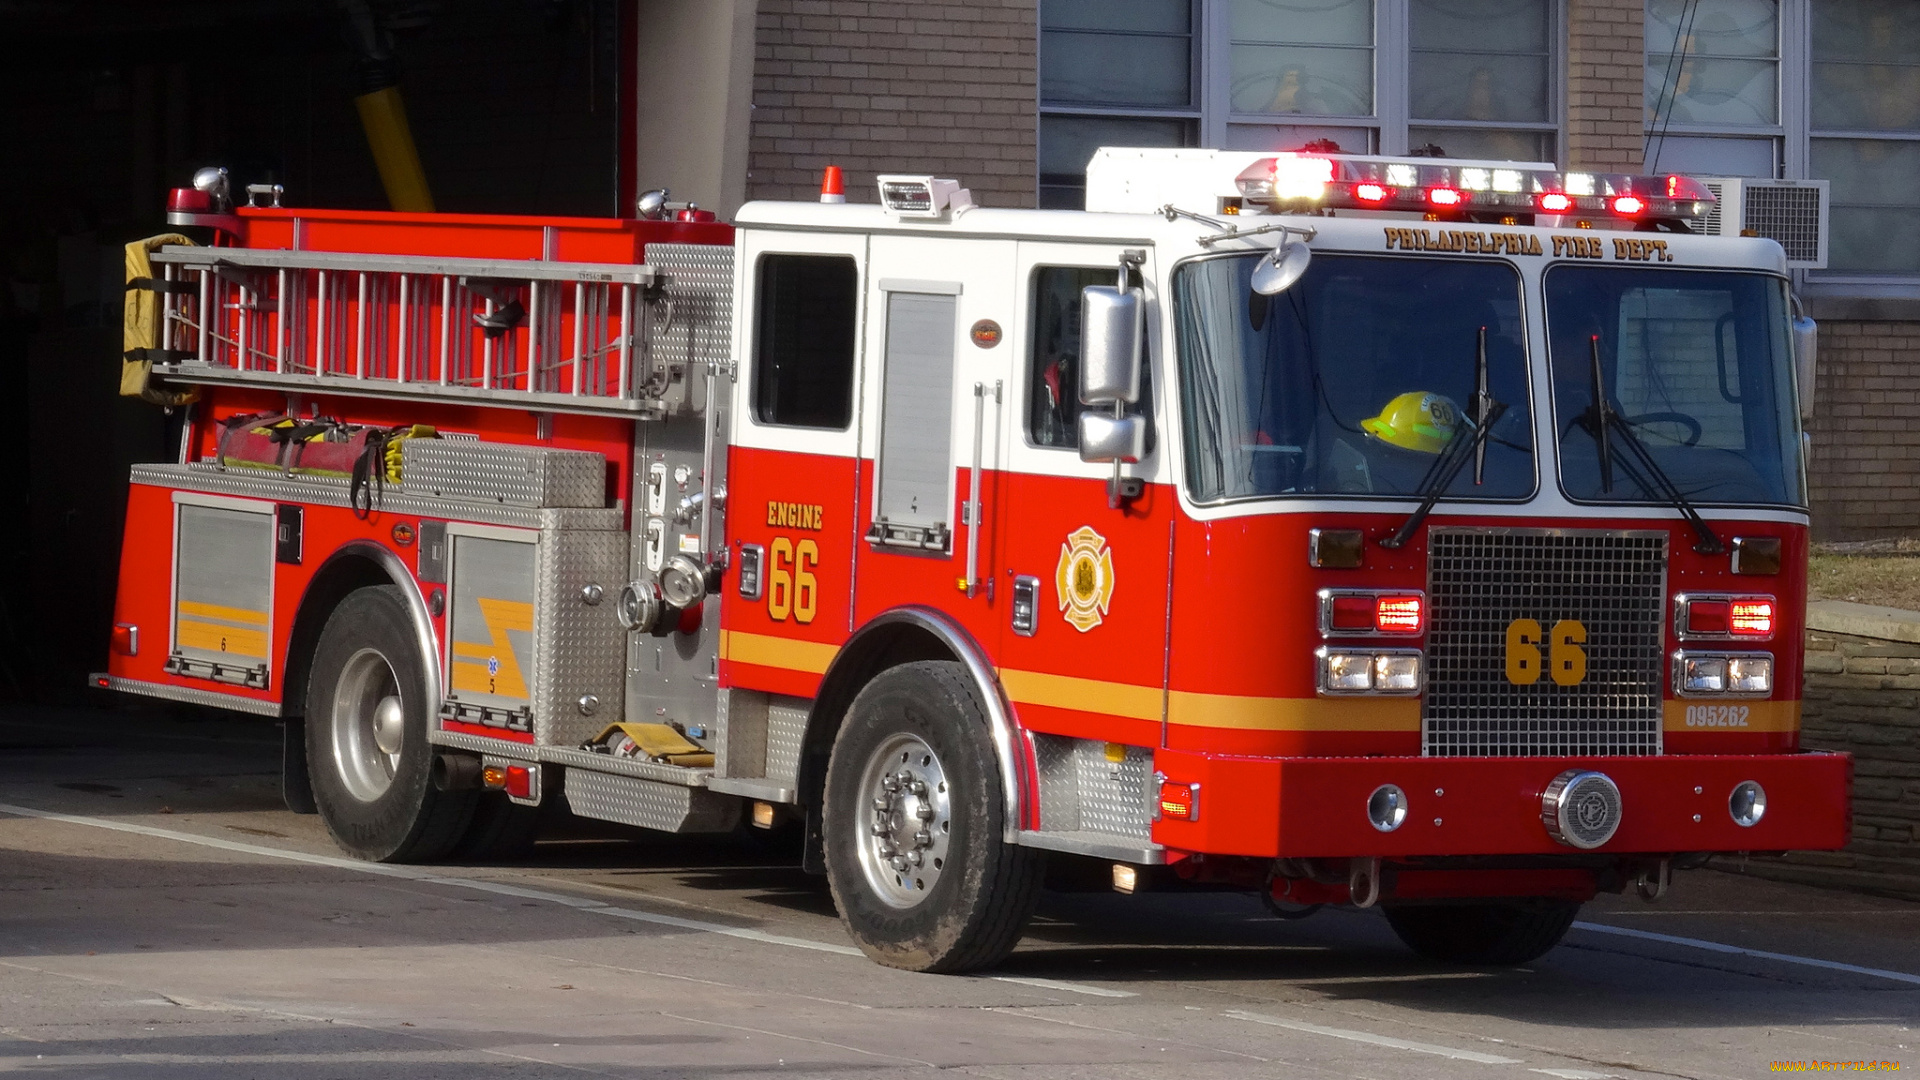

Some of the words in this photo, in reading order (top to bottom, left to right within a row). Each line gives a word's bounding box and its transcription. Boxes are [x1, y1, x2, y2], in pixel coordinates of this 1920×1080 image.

[1384, 227, 1543, 256] PHILADELPHIA
[1551, 235, 1603, 259] FIRE
[1613, 238, 1674, 262] DEPT.
[767, 500, 823, 531] ENGINE
[768, 536, 819, 625] 66
[221, 637, 227, 652] 6
[1505, 618, 1587, 686] 66
[489, 678, 495, 694] 5
[1685, 705, 1750, 727] 095262
